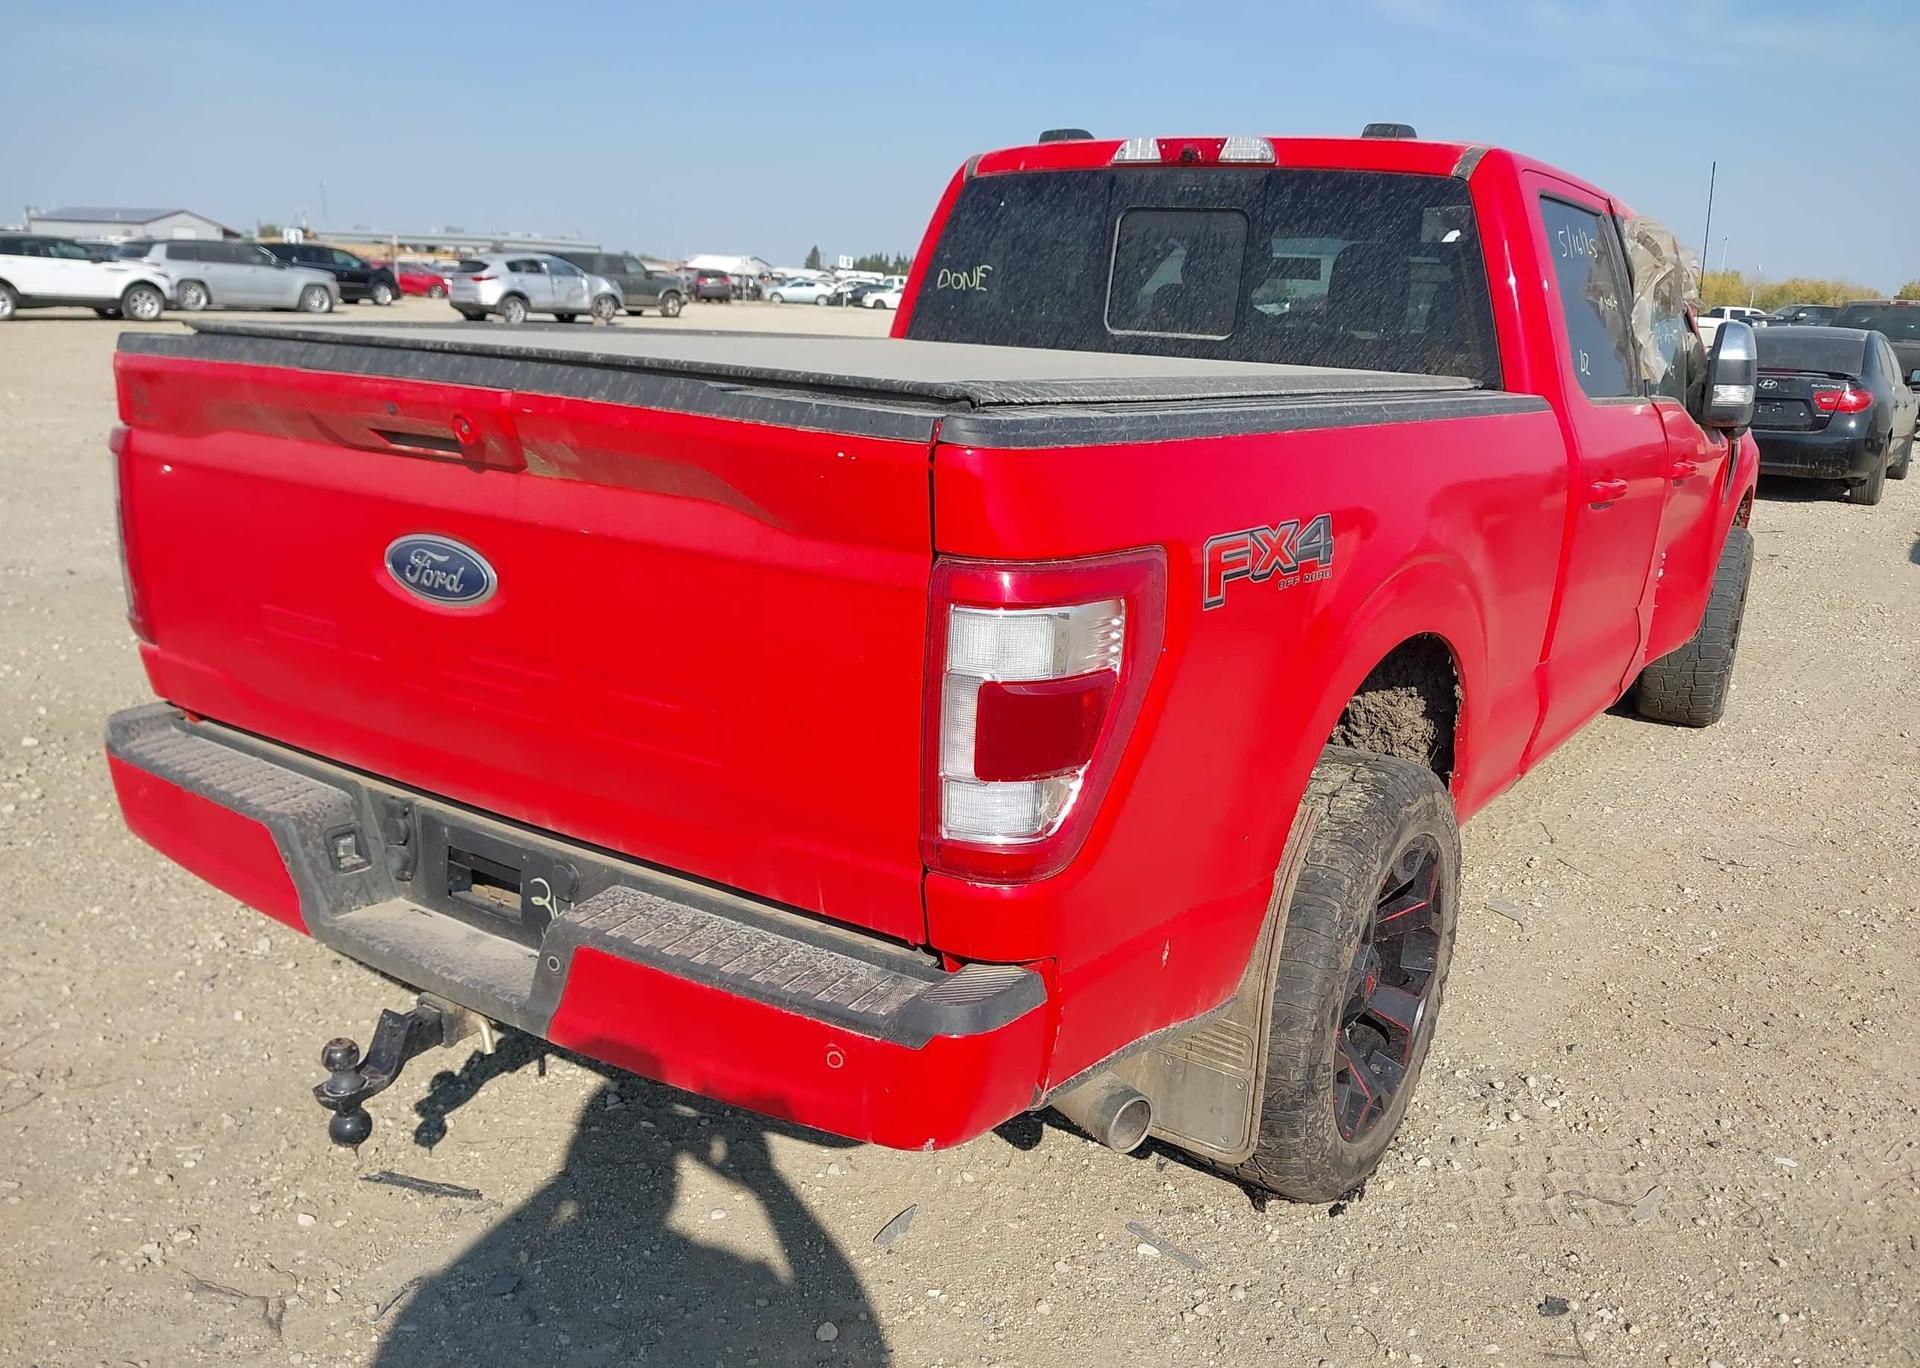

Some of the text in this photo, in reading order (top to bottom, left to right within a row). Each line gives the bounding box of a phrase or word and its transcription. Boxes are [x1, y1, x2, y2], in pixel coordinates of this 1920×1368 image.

[937, 264, 993, 292] DONE
[405, 548, 465, 593] Ford
[1203, 513, 1334, 611] FX4
[1277, 568, 1332, 590] OFF ROAD
